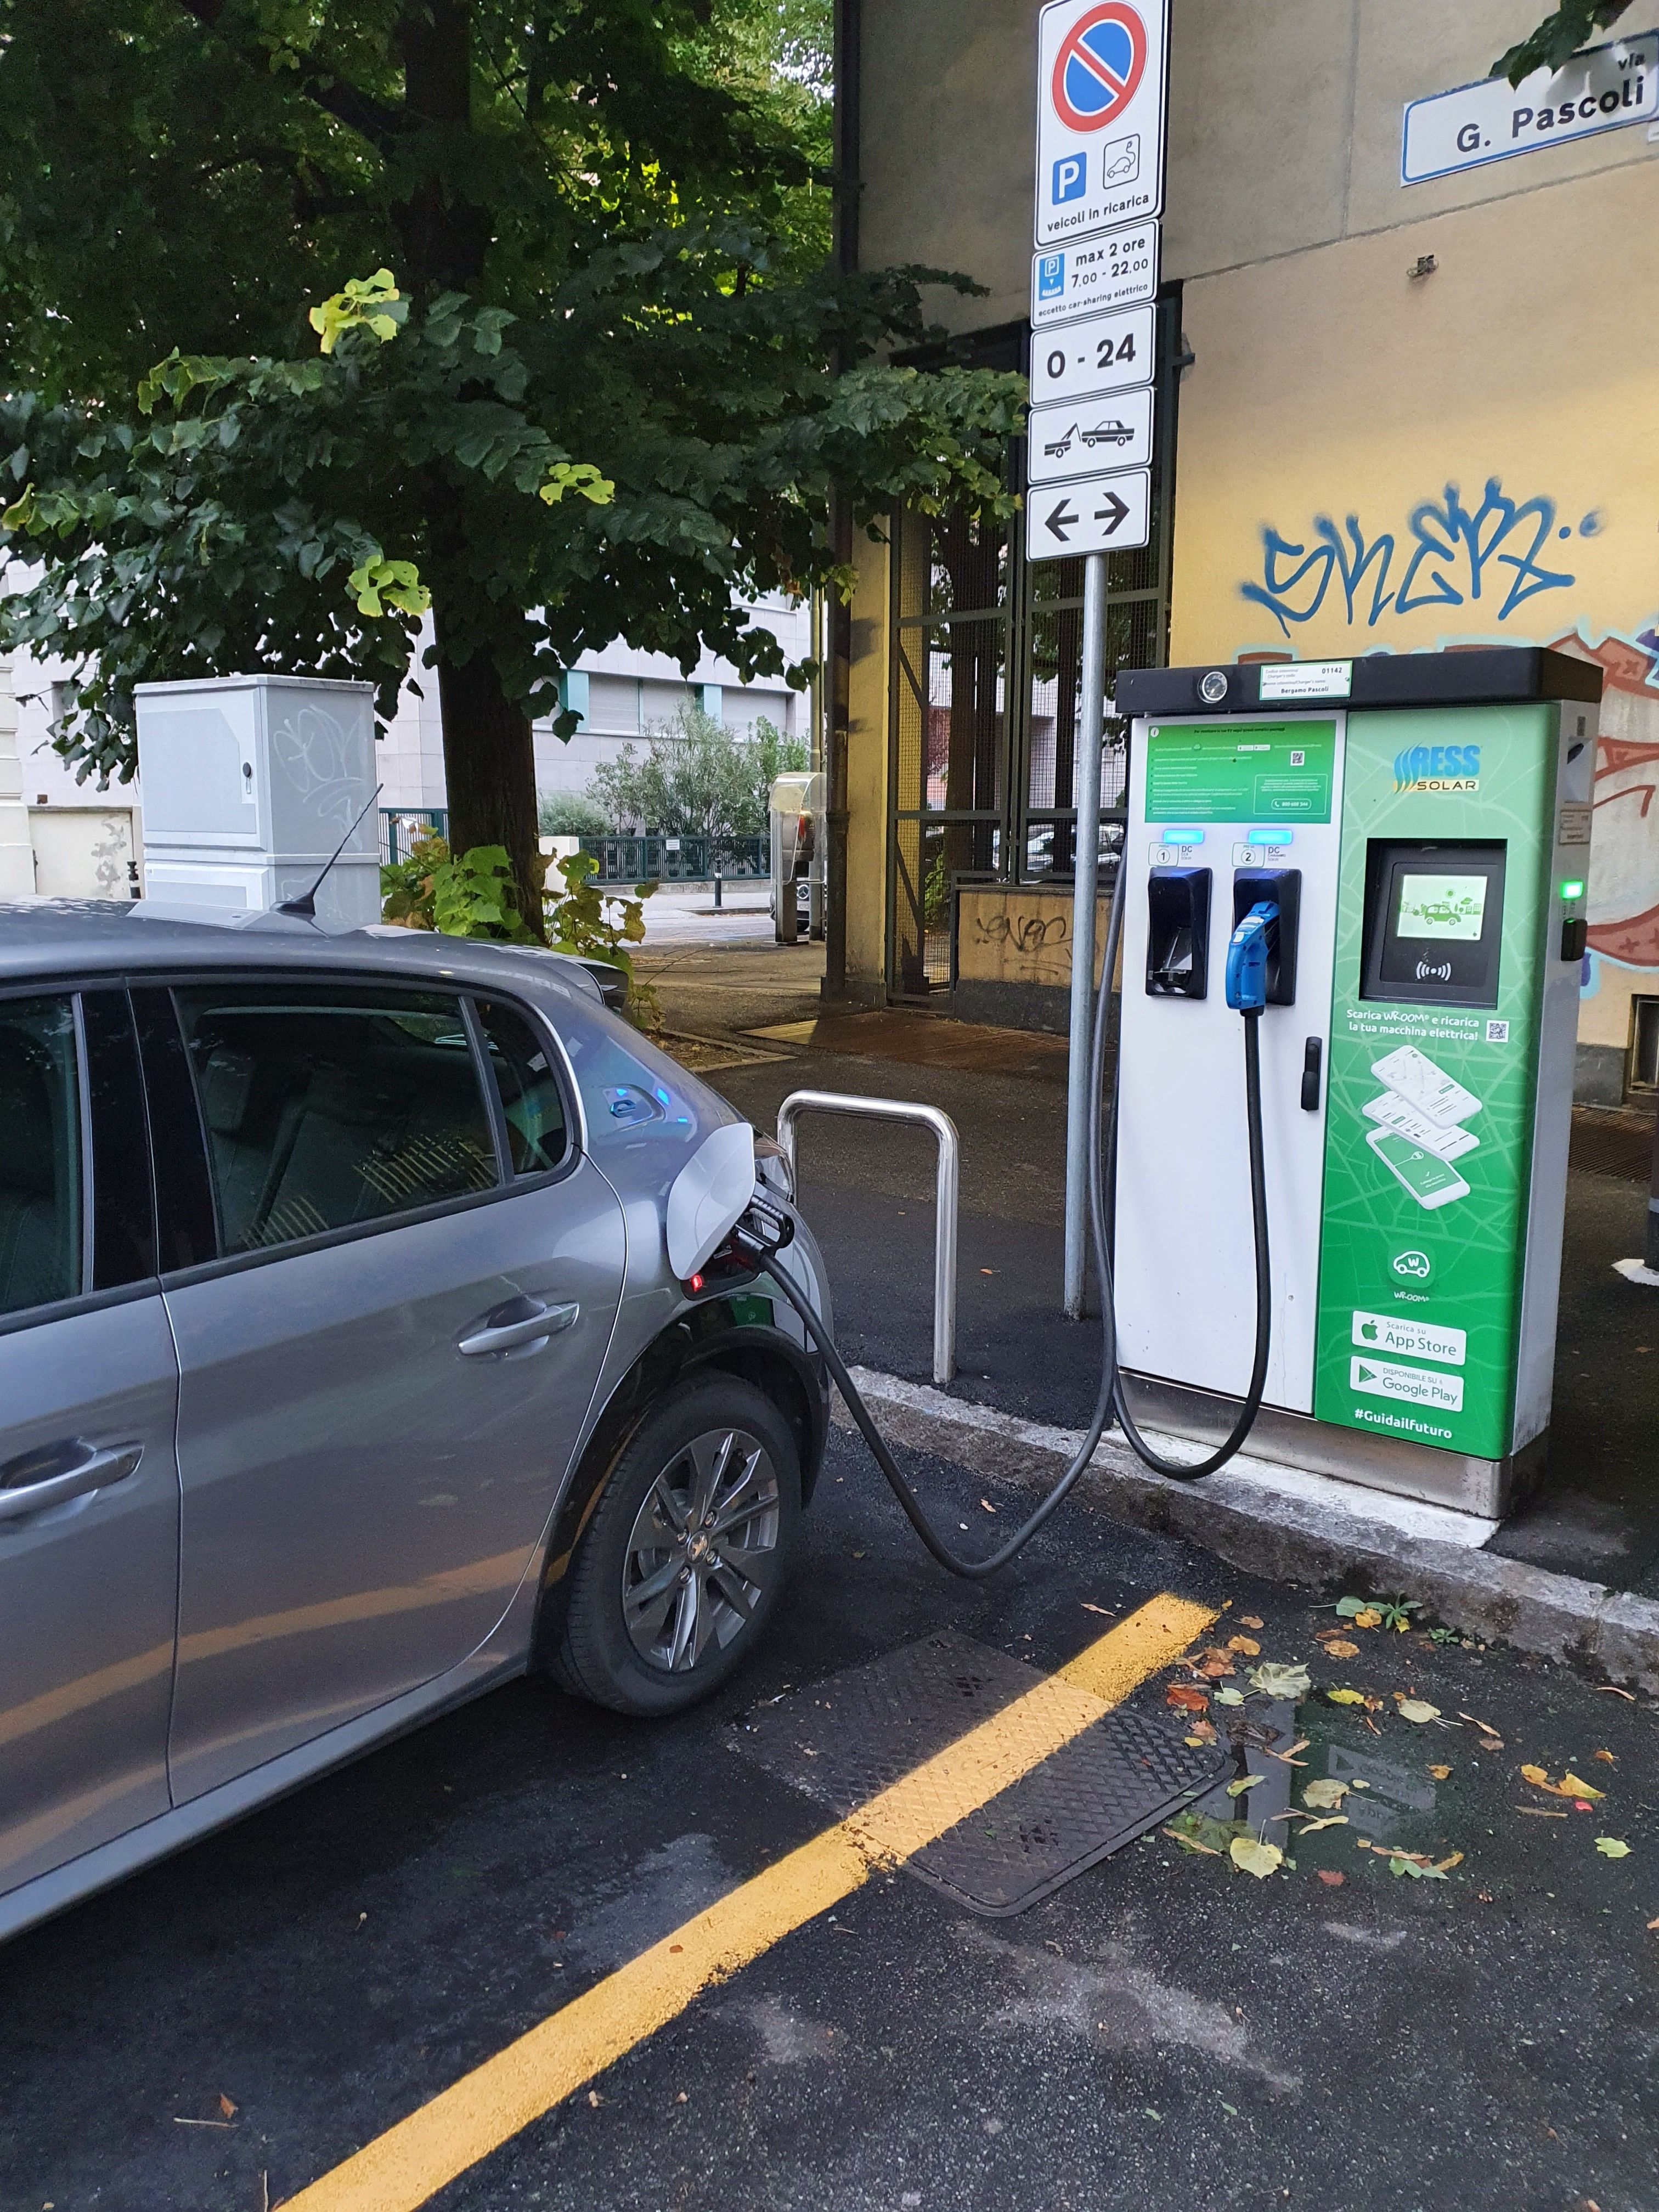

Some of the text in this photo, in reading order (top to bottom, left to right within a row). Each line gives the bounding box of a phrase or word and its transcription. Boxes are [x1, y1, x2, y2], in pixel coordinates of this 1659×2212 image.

[1457, 76, 1644, 153] G. Pascoli
[1059, 160, 1080, 199] P
[1047, 194, 1149, 232] veicoli in ricarica
[1076, 238, 1146, 267] max 2 ore
[1039, 284, 1148, 317] eccetto car-sharing elettrico
[1047, 350, 1065, 379] 0
[1097, 333, 1136, 369] 24
[1417, 781, 1476, 791] SOLAR
[1161, 851, 1165, 860] 1
[1245, 852, 1251, 861] 2
[1347, 1009, 1381, 1020] Scarica
[1441, 1016, 1480, 1027] ricarica
[1349, 1022, 1478, 1040] la tua macchina elettrica!
[1408, 1257, 1420, 1267] W
[1386, 1322, 1414, 1333] Scarica
[1385, 1331, 1457, 1356] App Store
[1383, 1368, 1437, 1384] DISPONIBILE SU
[1383, 1378, 1458, 1405] Google Play
[1355, 1408, 1452, 1438] #Guidailfuturo
